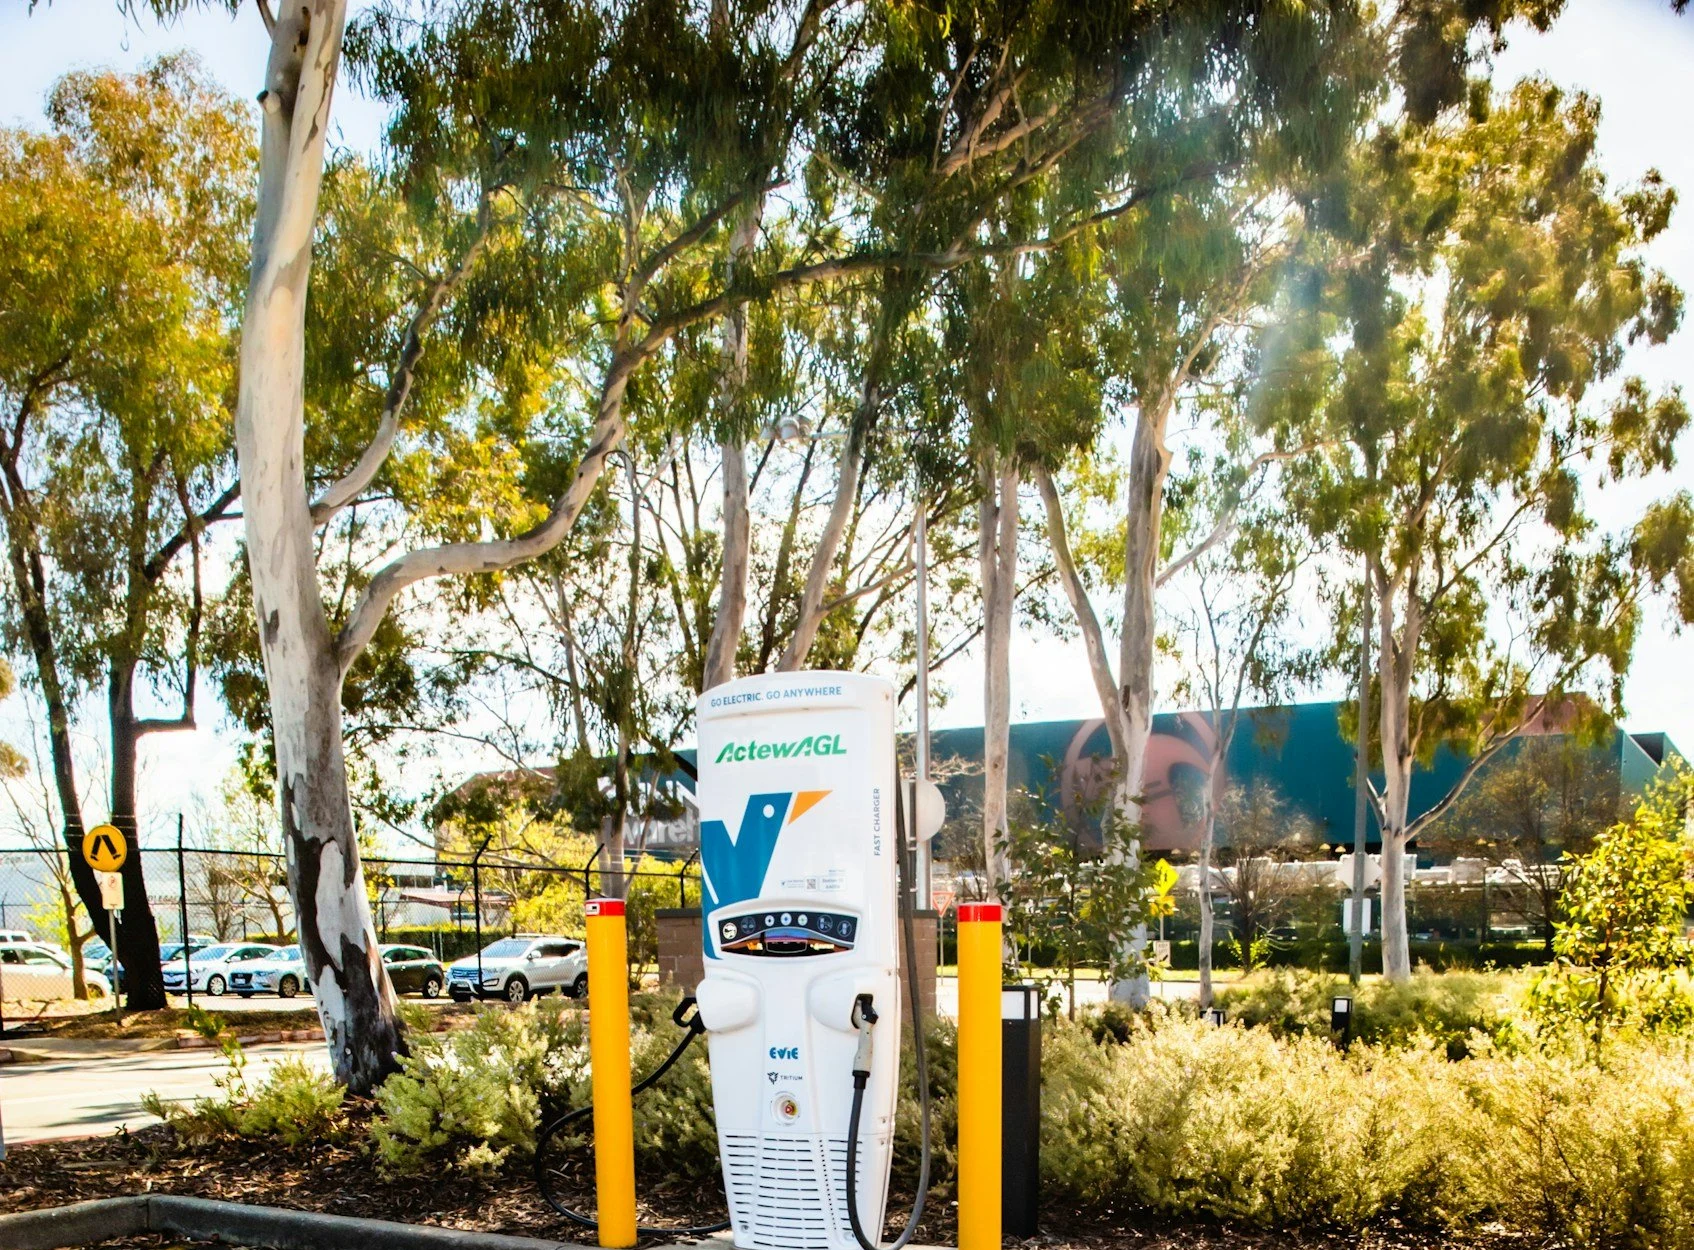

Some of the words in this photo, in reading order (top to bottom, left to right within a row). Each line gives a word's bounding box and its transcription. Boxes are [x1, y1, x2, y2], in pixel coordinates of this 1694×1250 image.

[711, 698, 722, 708] GO
[766, 690, 781, 700] GO
[783, 686, 842, 698] ANYWHERE
[715, 734, 847, 764] ActewAGL
[873, 788, 881, 832] CHARGER
[873, 834, 881, 856] FAST
